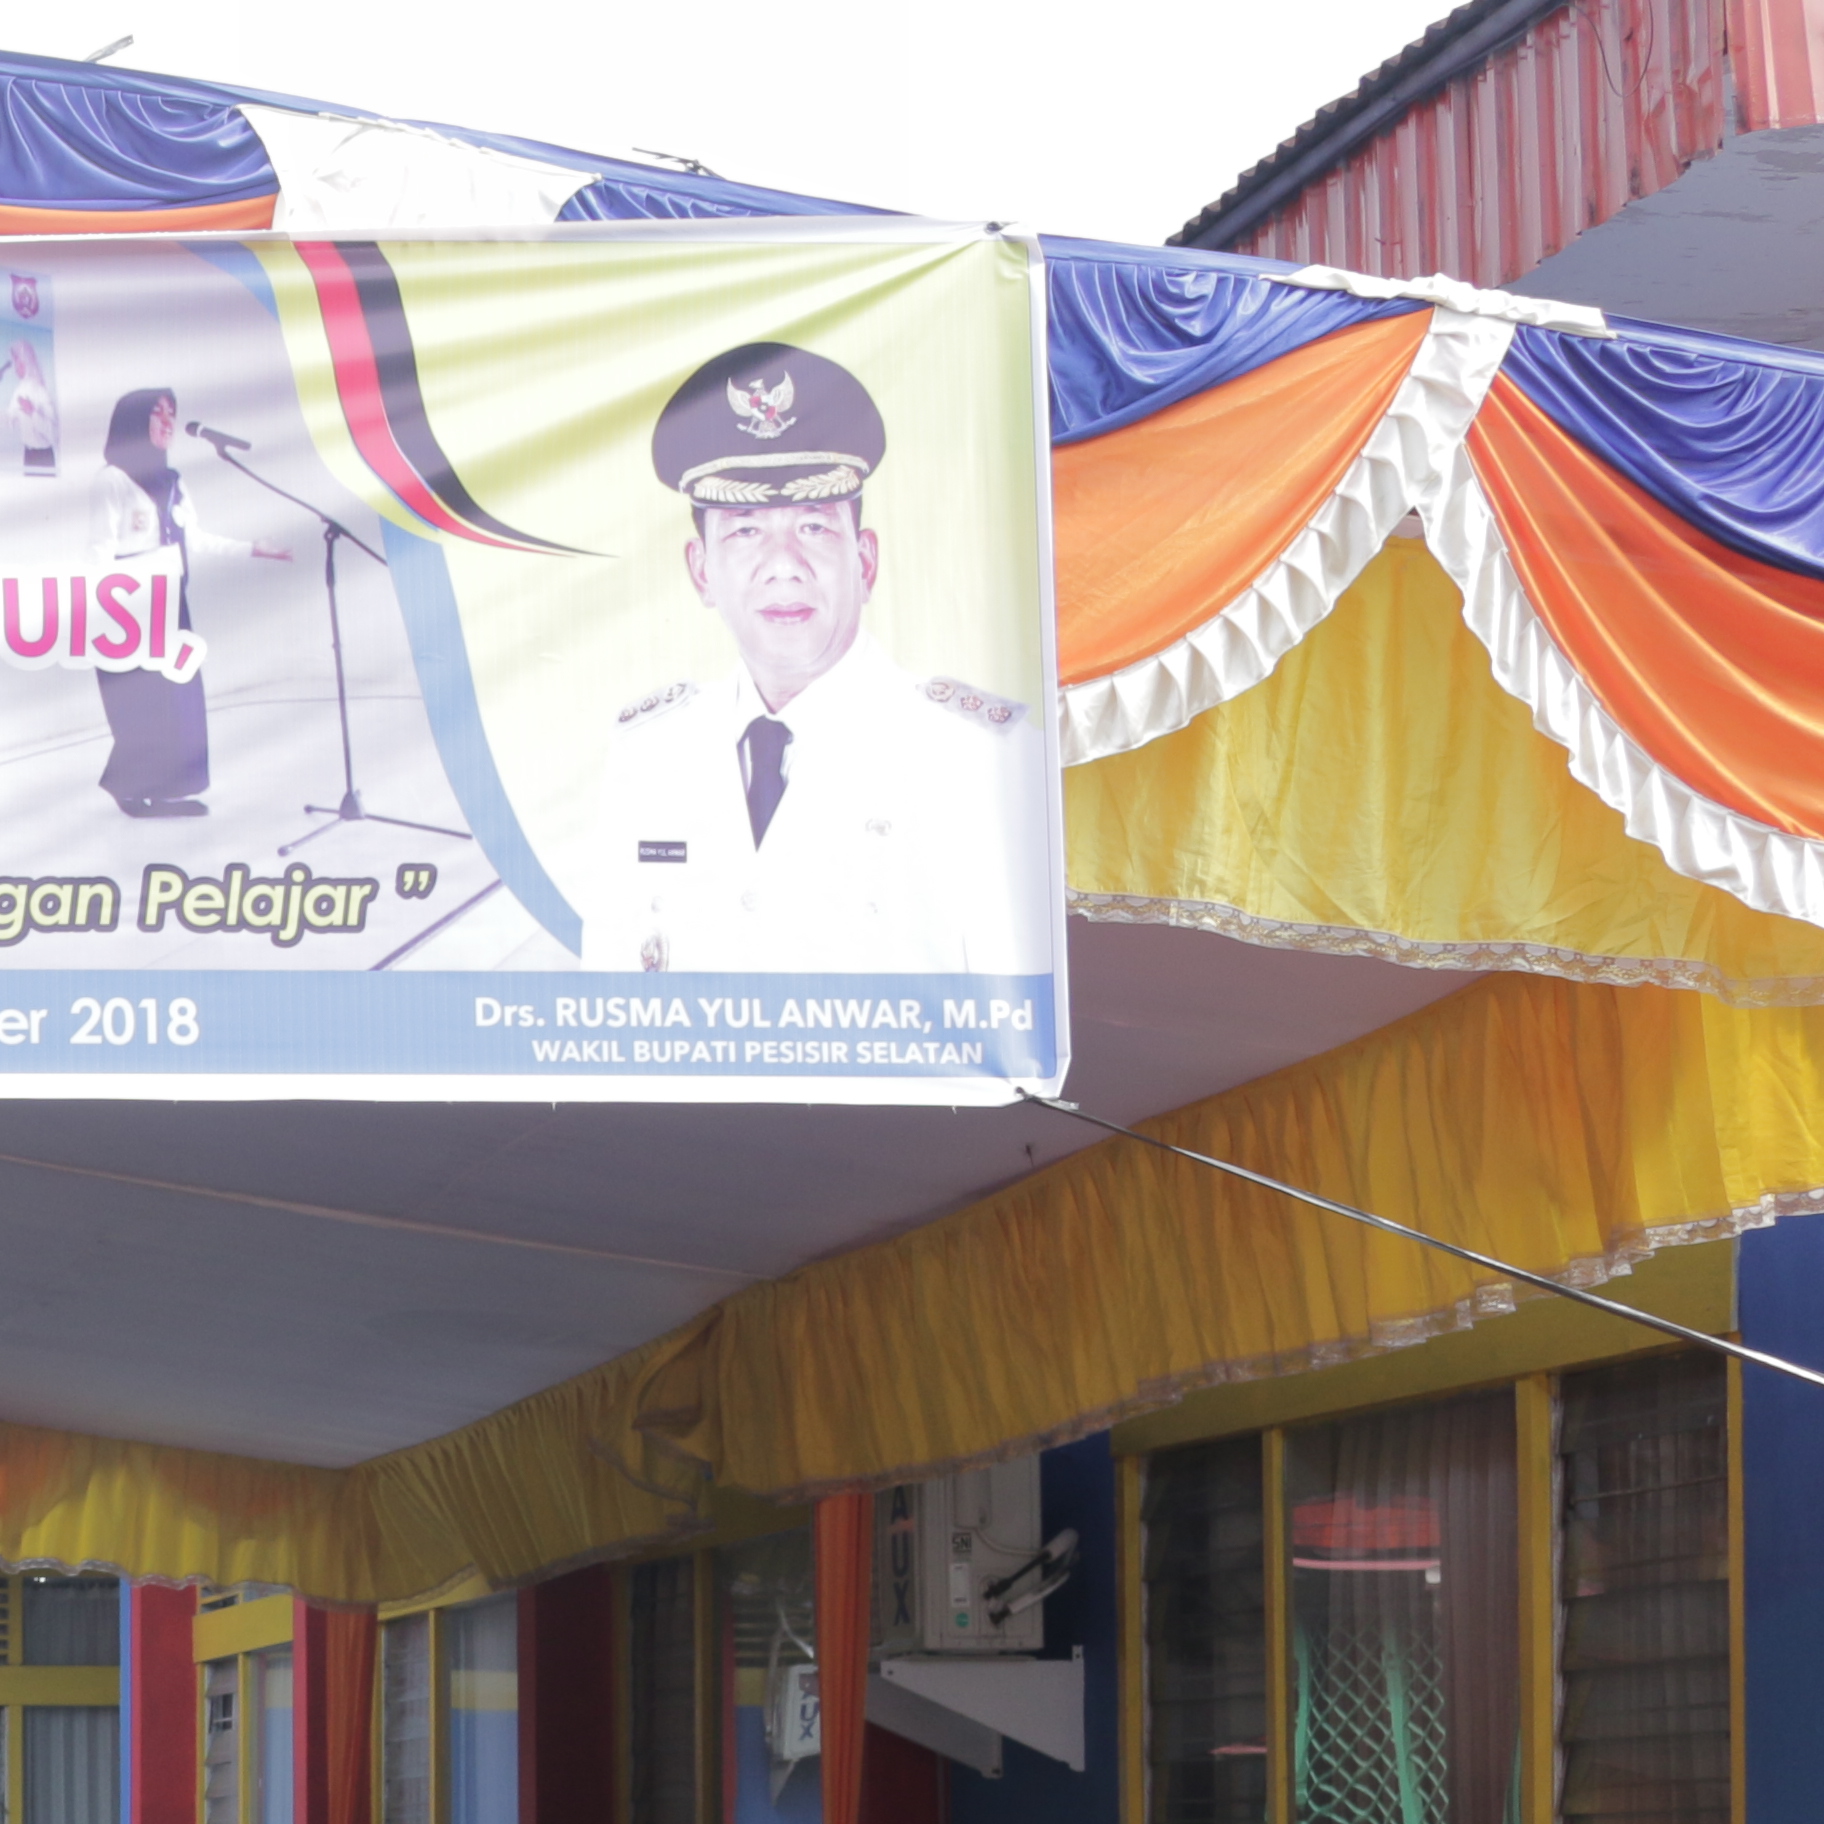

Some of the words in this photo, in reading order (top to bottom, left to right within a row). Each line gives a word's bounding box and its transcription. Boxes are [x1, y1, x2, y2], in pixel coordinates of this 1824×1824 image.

[148, 869, 374, 942] Pelajar
[70, 999, 200, 1047] 2018
[474, 998, 547, 1028] Drs.
[555, 999, 690, 1029] RUSMA
[697, 998, 771, 1029] YUL
[779, 999, 935, 1034] ANWAR,
[944, 1000, 1034, 1032] M.Pd
[532, 1039, 627, 1064] WAKIL
[633, 1039, 737, 1064] BUPATI
[744, 1039, 852, 1065] PESISIR
[856, 1041, 983, 1066] SELATAN
[890, 1486, 911, 1626] AUX
